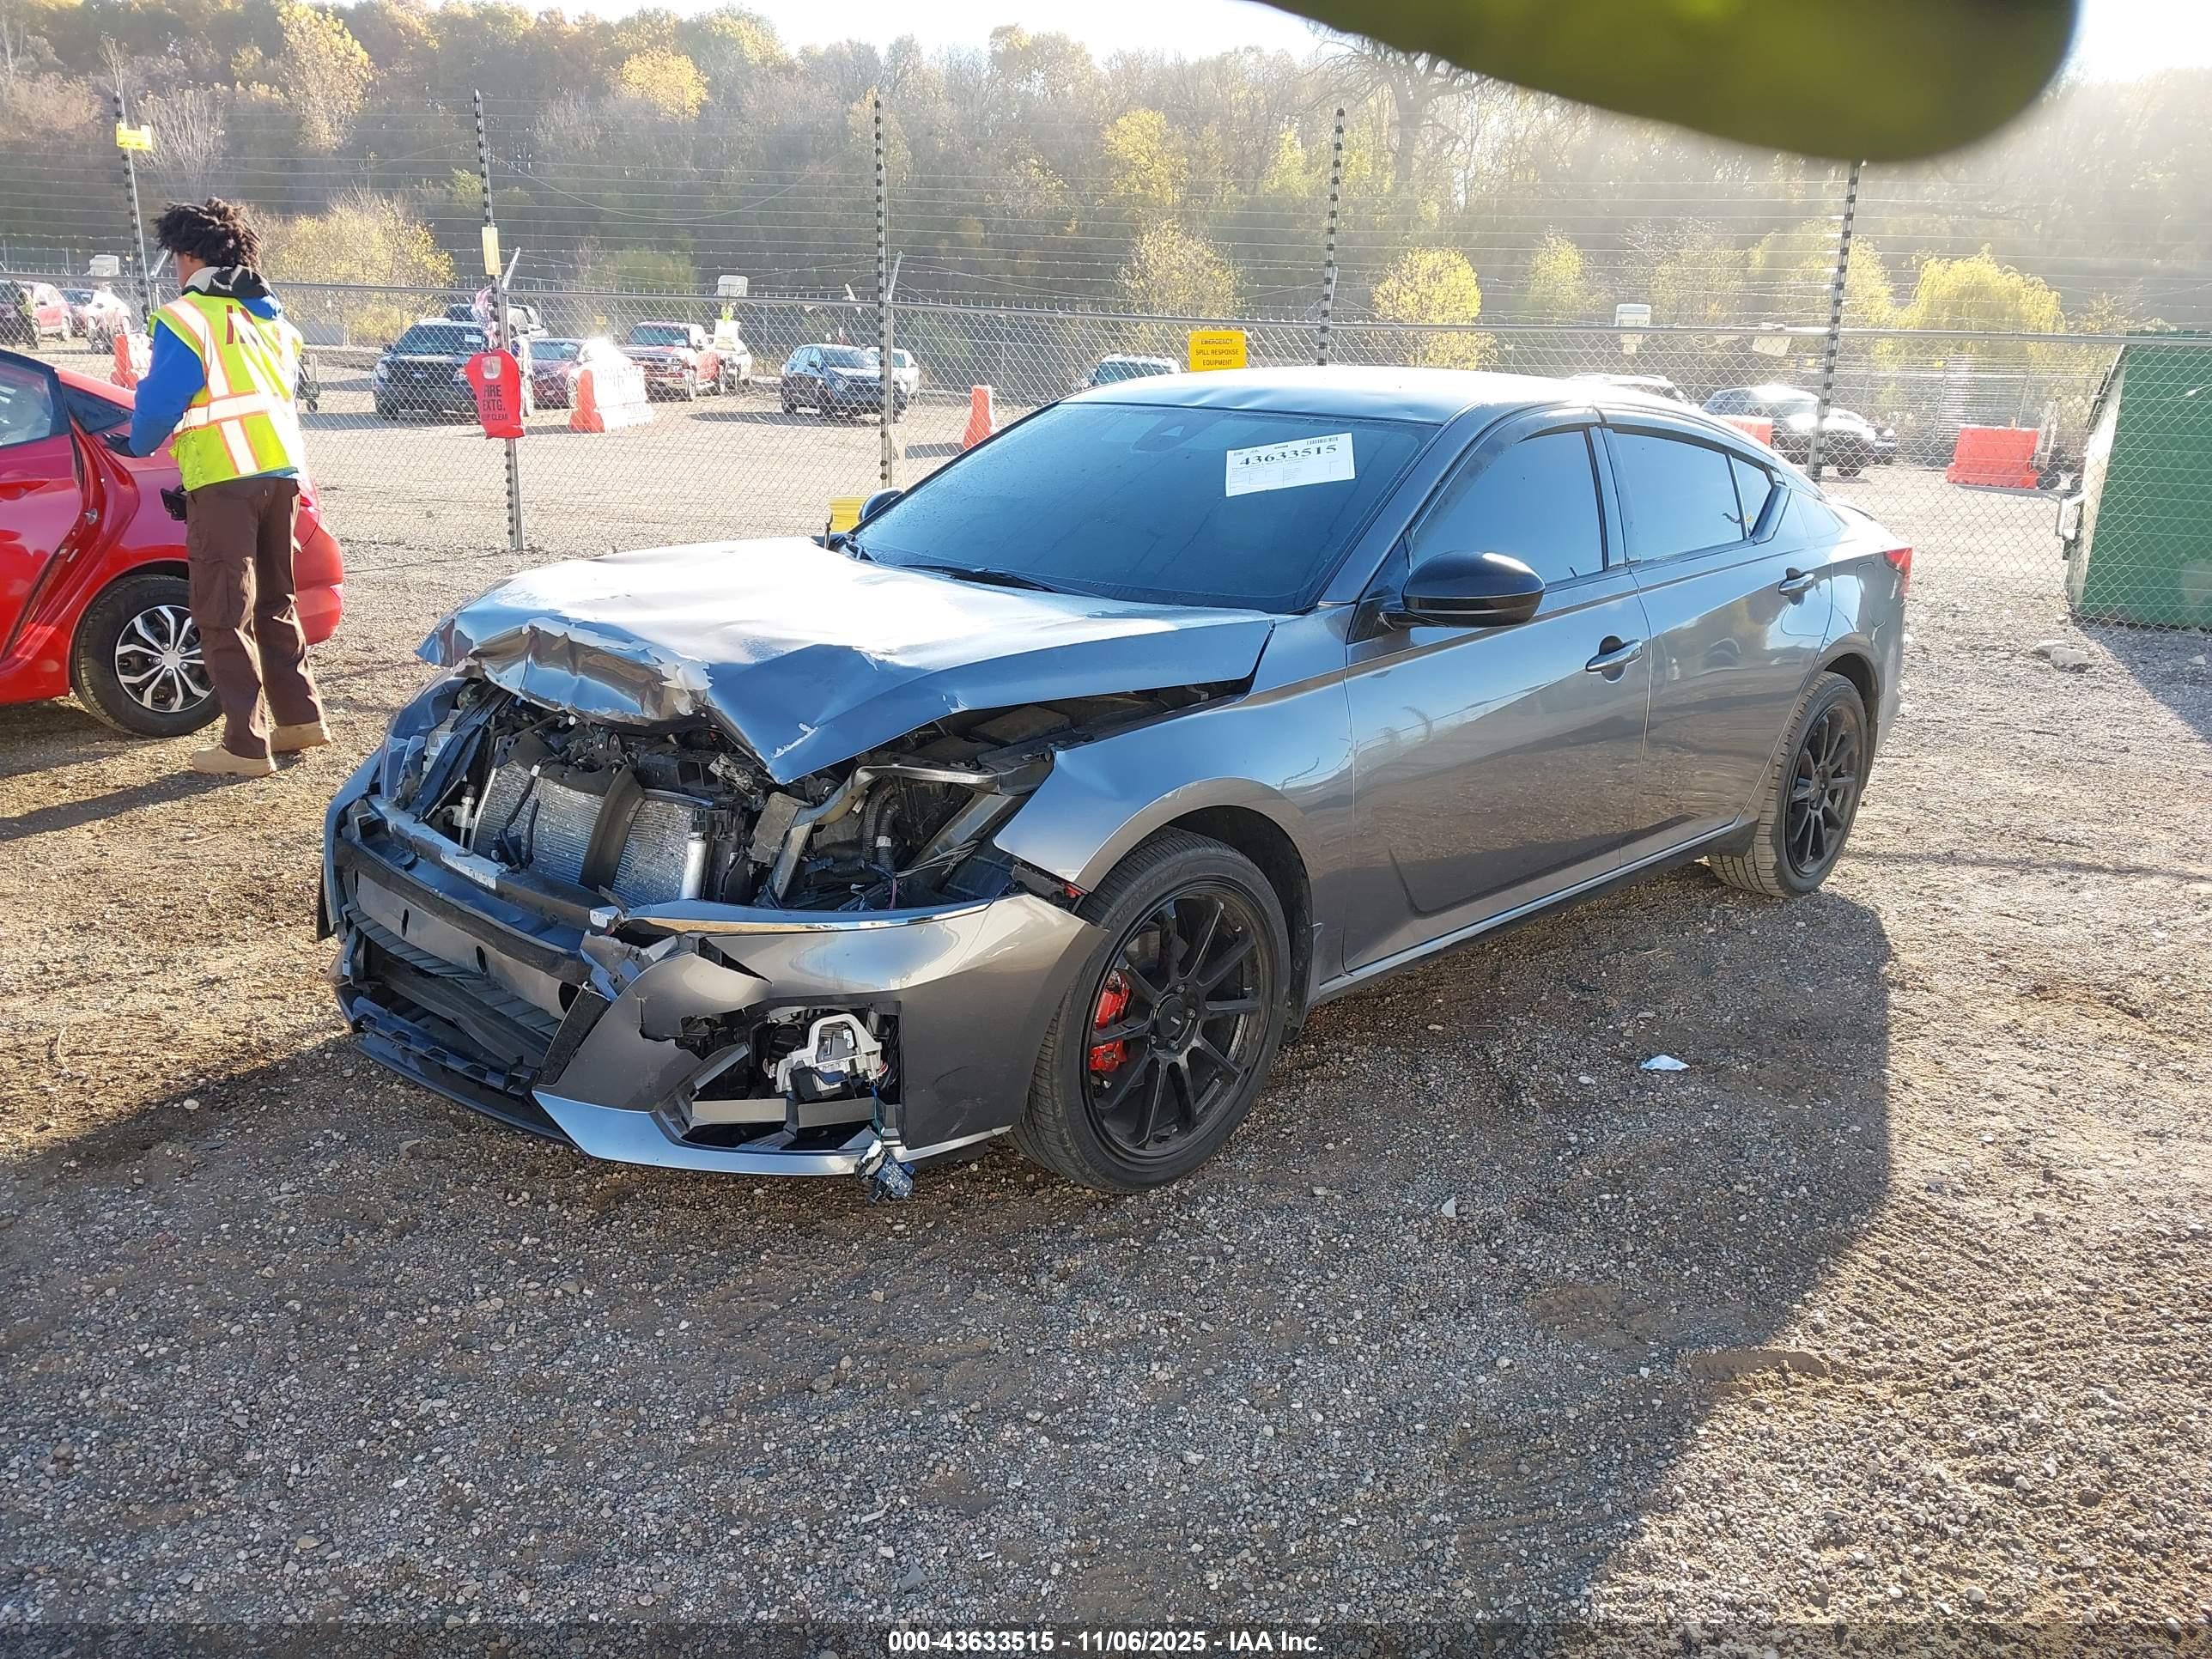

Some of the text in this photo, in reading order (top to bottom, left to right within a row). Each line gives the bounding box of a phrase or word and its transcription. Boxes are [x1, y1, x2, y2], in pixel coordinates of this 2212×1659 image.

[484, 385, 501, 398] FIRE
[483, 399, 505, 411] EXTG.
[1240, 444, 1337, 465] 43633515
